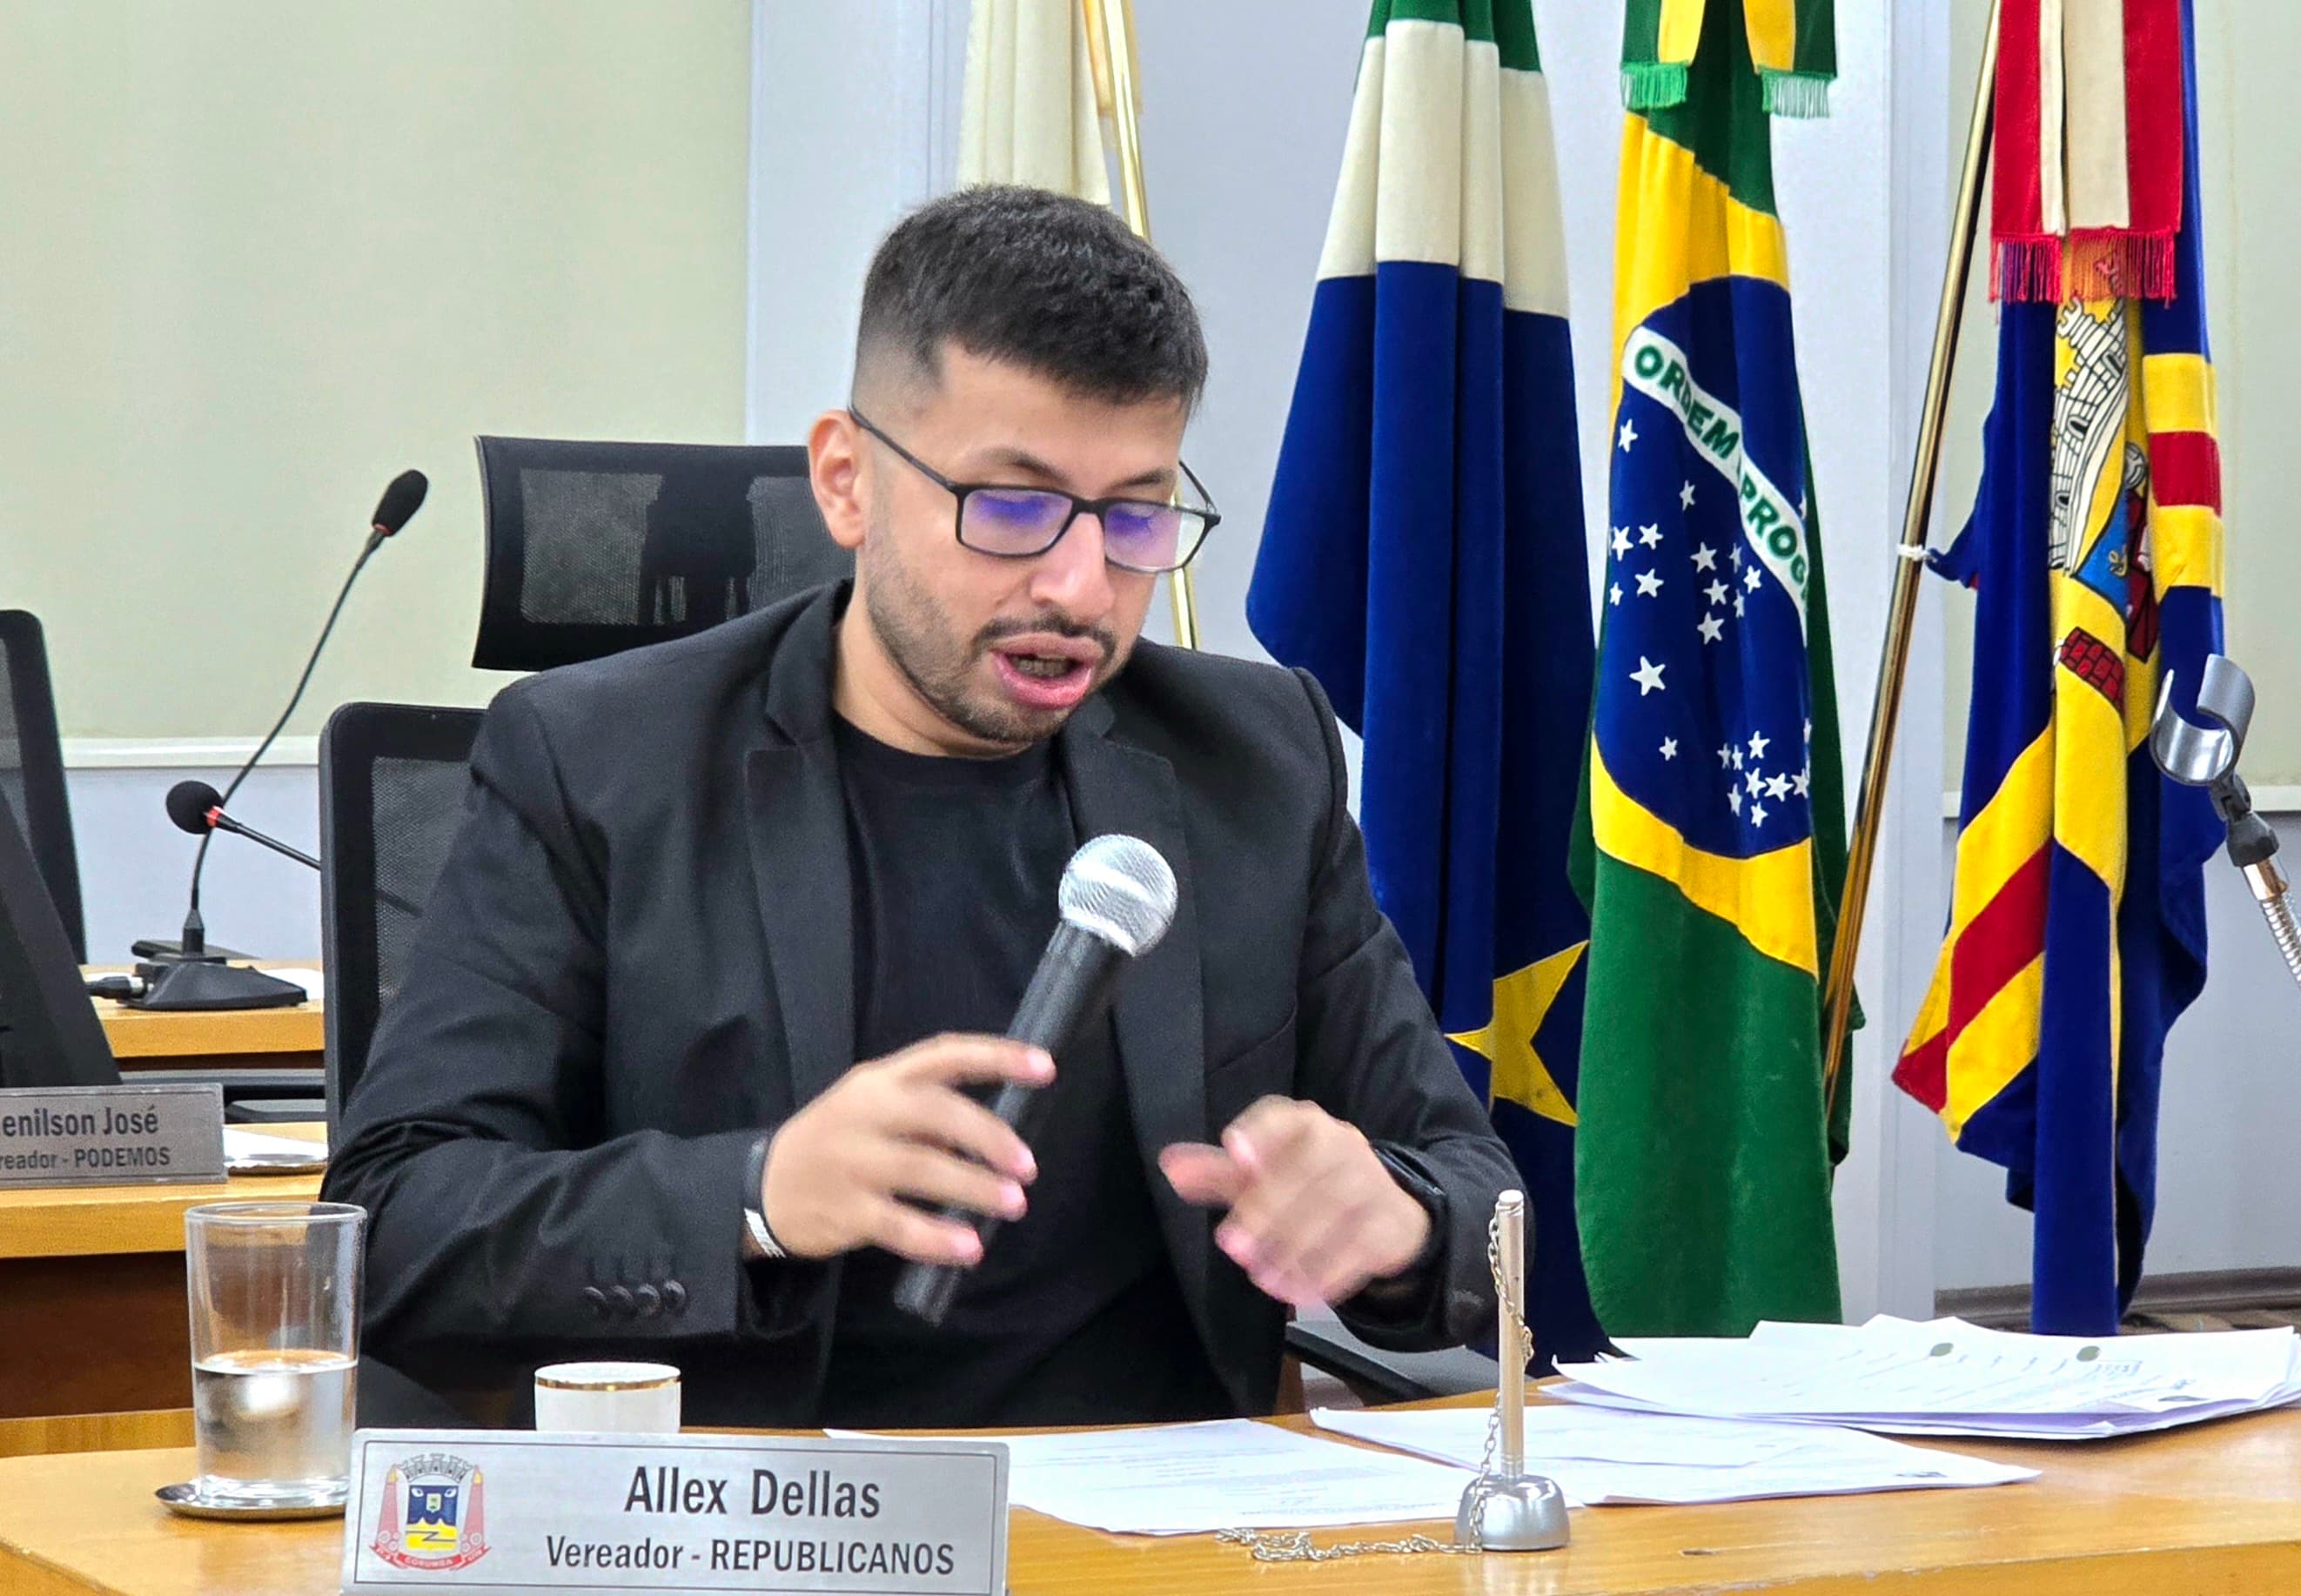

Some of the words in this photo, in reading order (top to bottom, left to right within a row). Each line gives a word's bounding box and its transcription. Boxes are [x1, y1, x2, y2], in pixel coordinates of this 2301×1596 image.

[1634, 345, 1740, 459] ORDEM
[1741, 471, 1808, 600] PROG
[3, 1107, 96, 1137] enilson
[103, 1105, 159, 1136] José
[74, 1146, 171, 1169] PODEMOS
[623, 1465, 729, 1515] Allex
[751, 1468, 881, 1519] Dellas
[546, 1535, 684, 1569] Vereador
[710, 1539, 955, 1575] REPUBLICANOS
